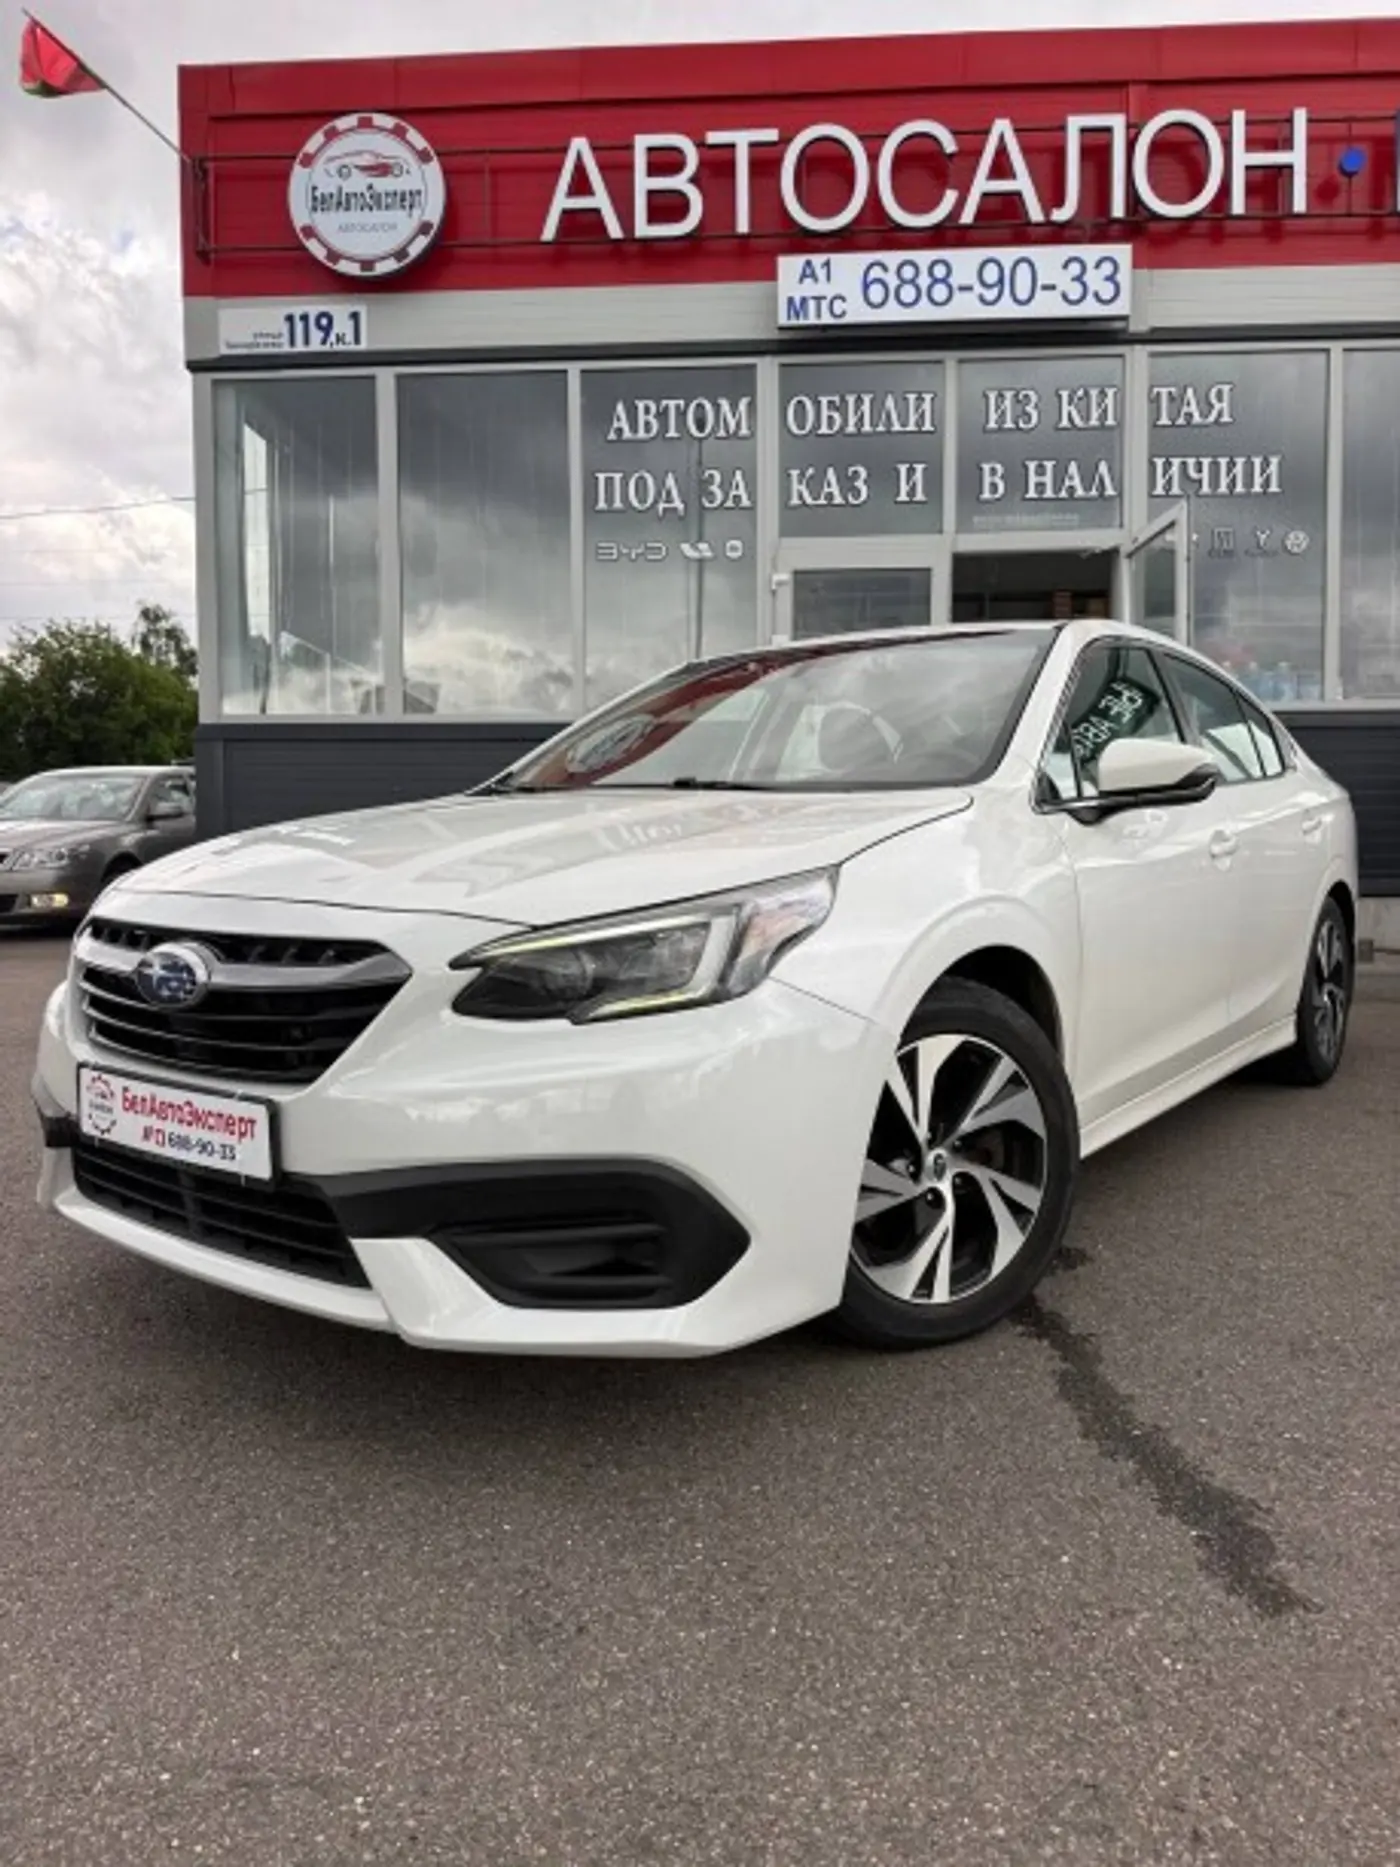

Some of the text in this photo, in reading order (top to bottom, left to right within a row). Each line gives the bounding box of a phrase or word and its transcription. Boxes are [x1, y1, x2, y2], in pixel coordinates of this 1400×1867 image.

[541, 108, 1307, 242] АВТОСАЛОН
[797, 258, 833, 286] A1
[859, 254, 1122, 311] 688-90-33
[785, 294, 848, 321] МТС
[985, 390, 1039, 430] ИЗ
[595, 471, 686, 517] ПОД
[896, 463, 927, 502] И
[980, 462, 1006, 500] В
[121, 1086, 257, 1143] БелАвтоЭксперт
